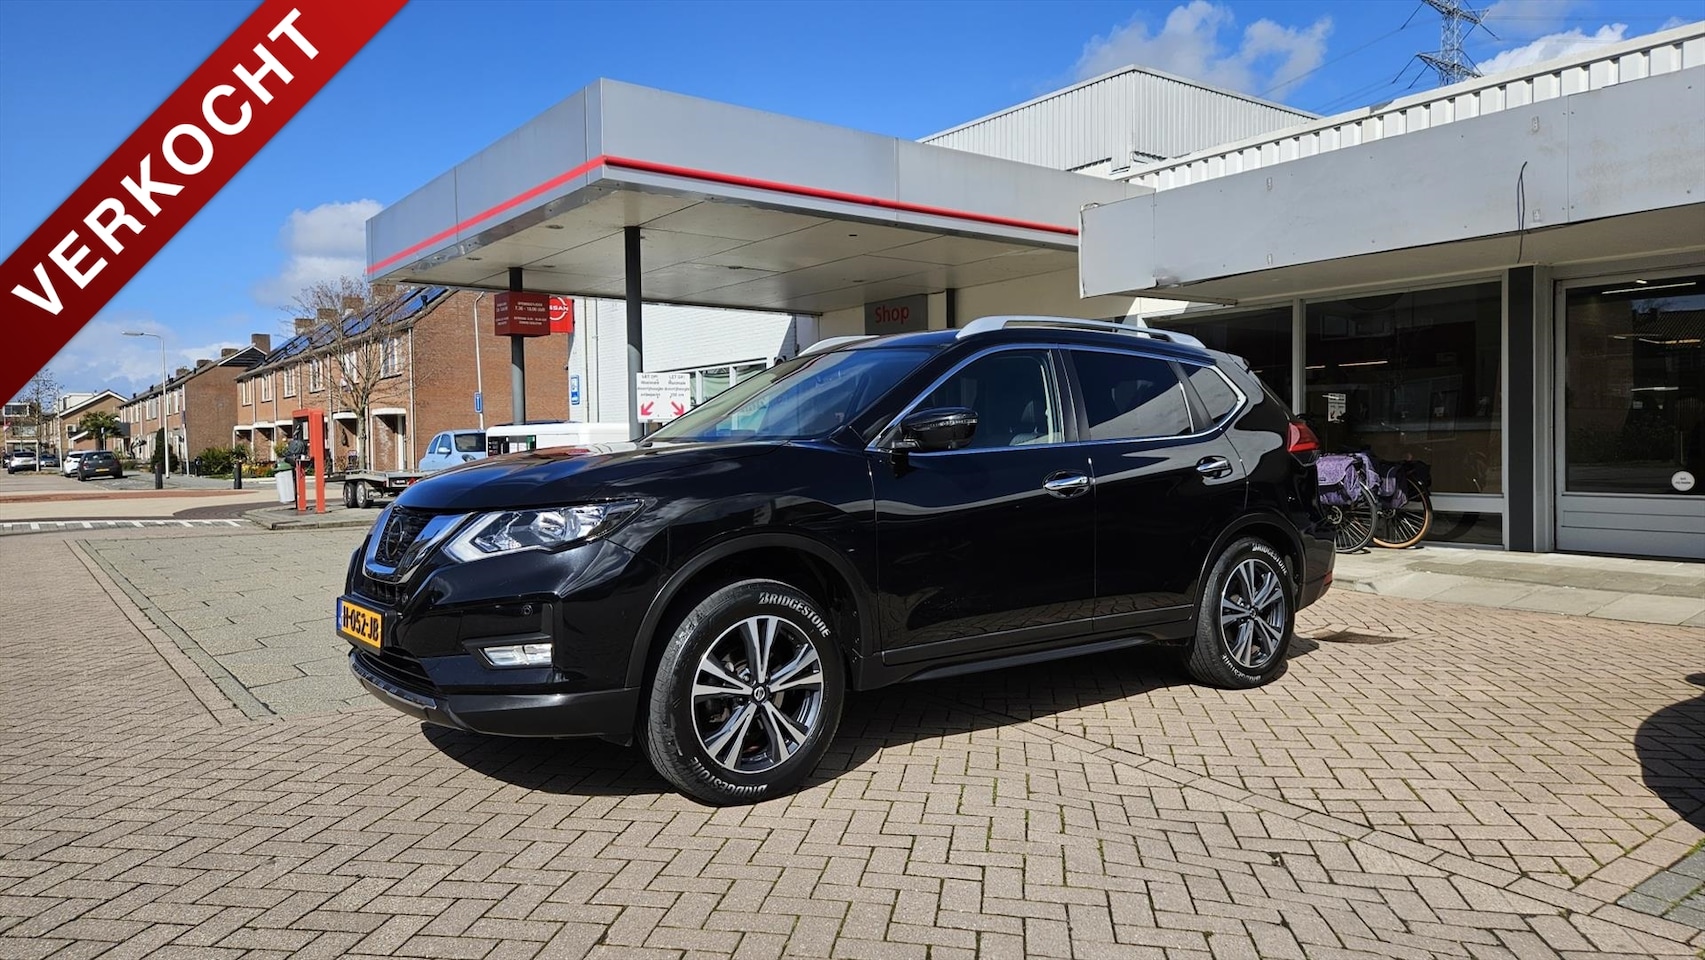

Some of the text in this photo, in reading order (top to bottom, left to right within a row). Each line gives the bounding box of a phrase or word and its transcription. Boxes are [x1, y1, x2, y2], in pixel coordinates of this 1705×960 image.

[875, 305, 909, 325] Shop
[343, 605, 379, 642] H-052-JB
[758, 591, 831, 638] BRIDGESTONE
